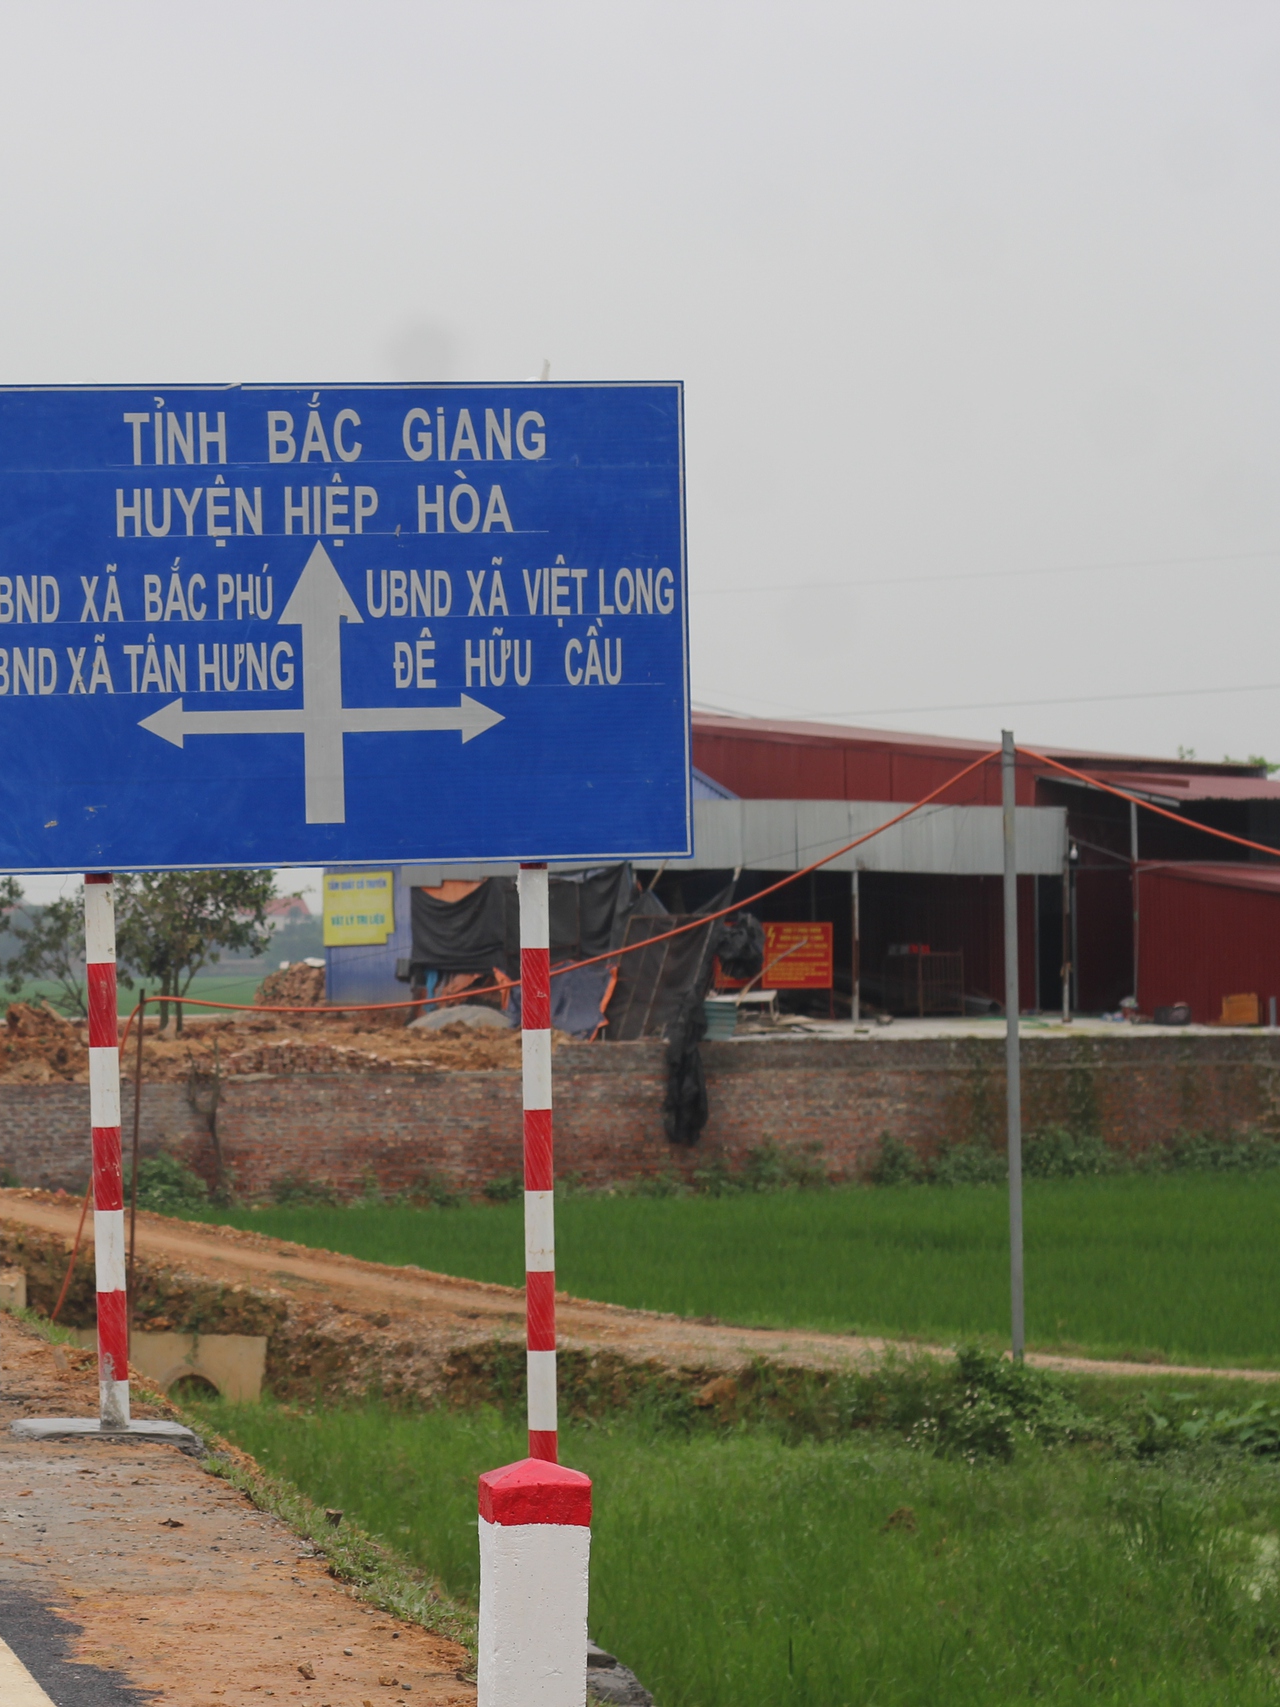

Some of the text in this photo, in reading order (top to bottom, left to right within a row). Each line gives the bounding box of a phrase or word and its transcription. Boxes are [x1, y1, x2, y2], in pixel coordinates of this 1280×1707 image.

[123, 396, 227, 465] TỈNH
[267, 392, 362, 463] BẮC
[116, 469, 514, 547] HUYỆN HIỆP HÒA
[80, 563, 124, 622] XÃ
[144, 557, 207, 621] BẮC
[217, 563, 273, 620] PHÚ
[366, 554, 675, 627] UBND XÃ VIỆT LONG
[66, 633, 114, 694] XÃ
[123, 633, 187, 693] TÂN
[198, 641, 295, 692] HƯNG
[393, 617, 621, 688] ĐÊ HỮU CẦU
